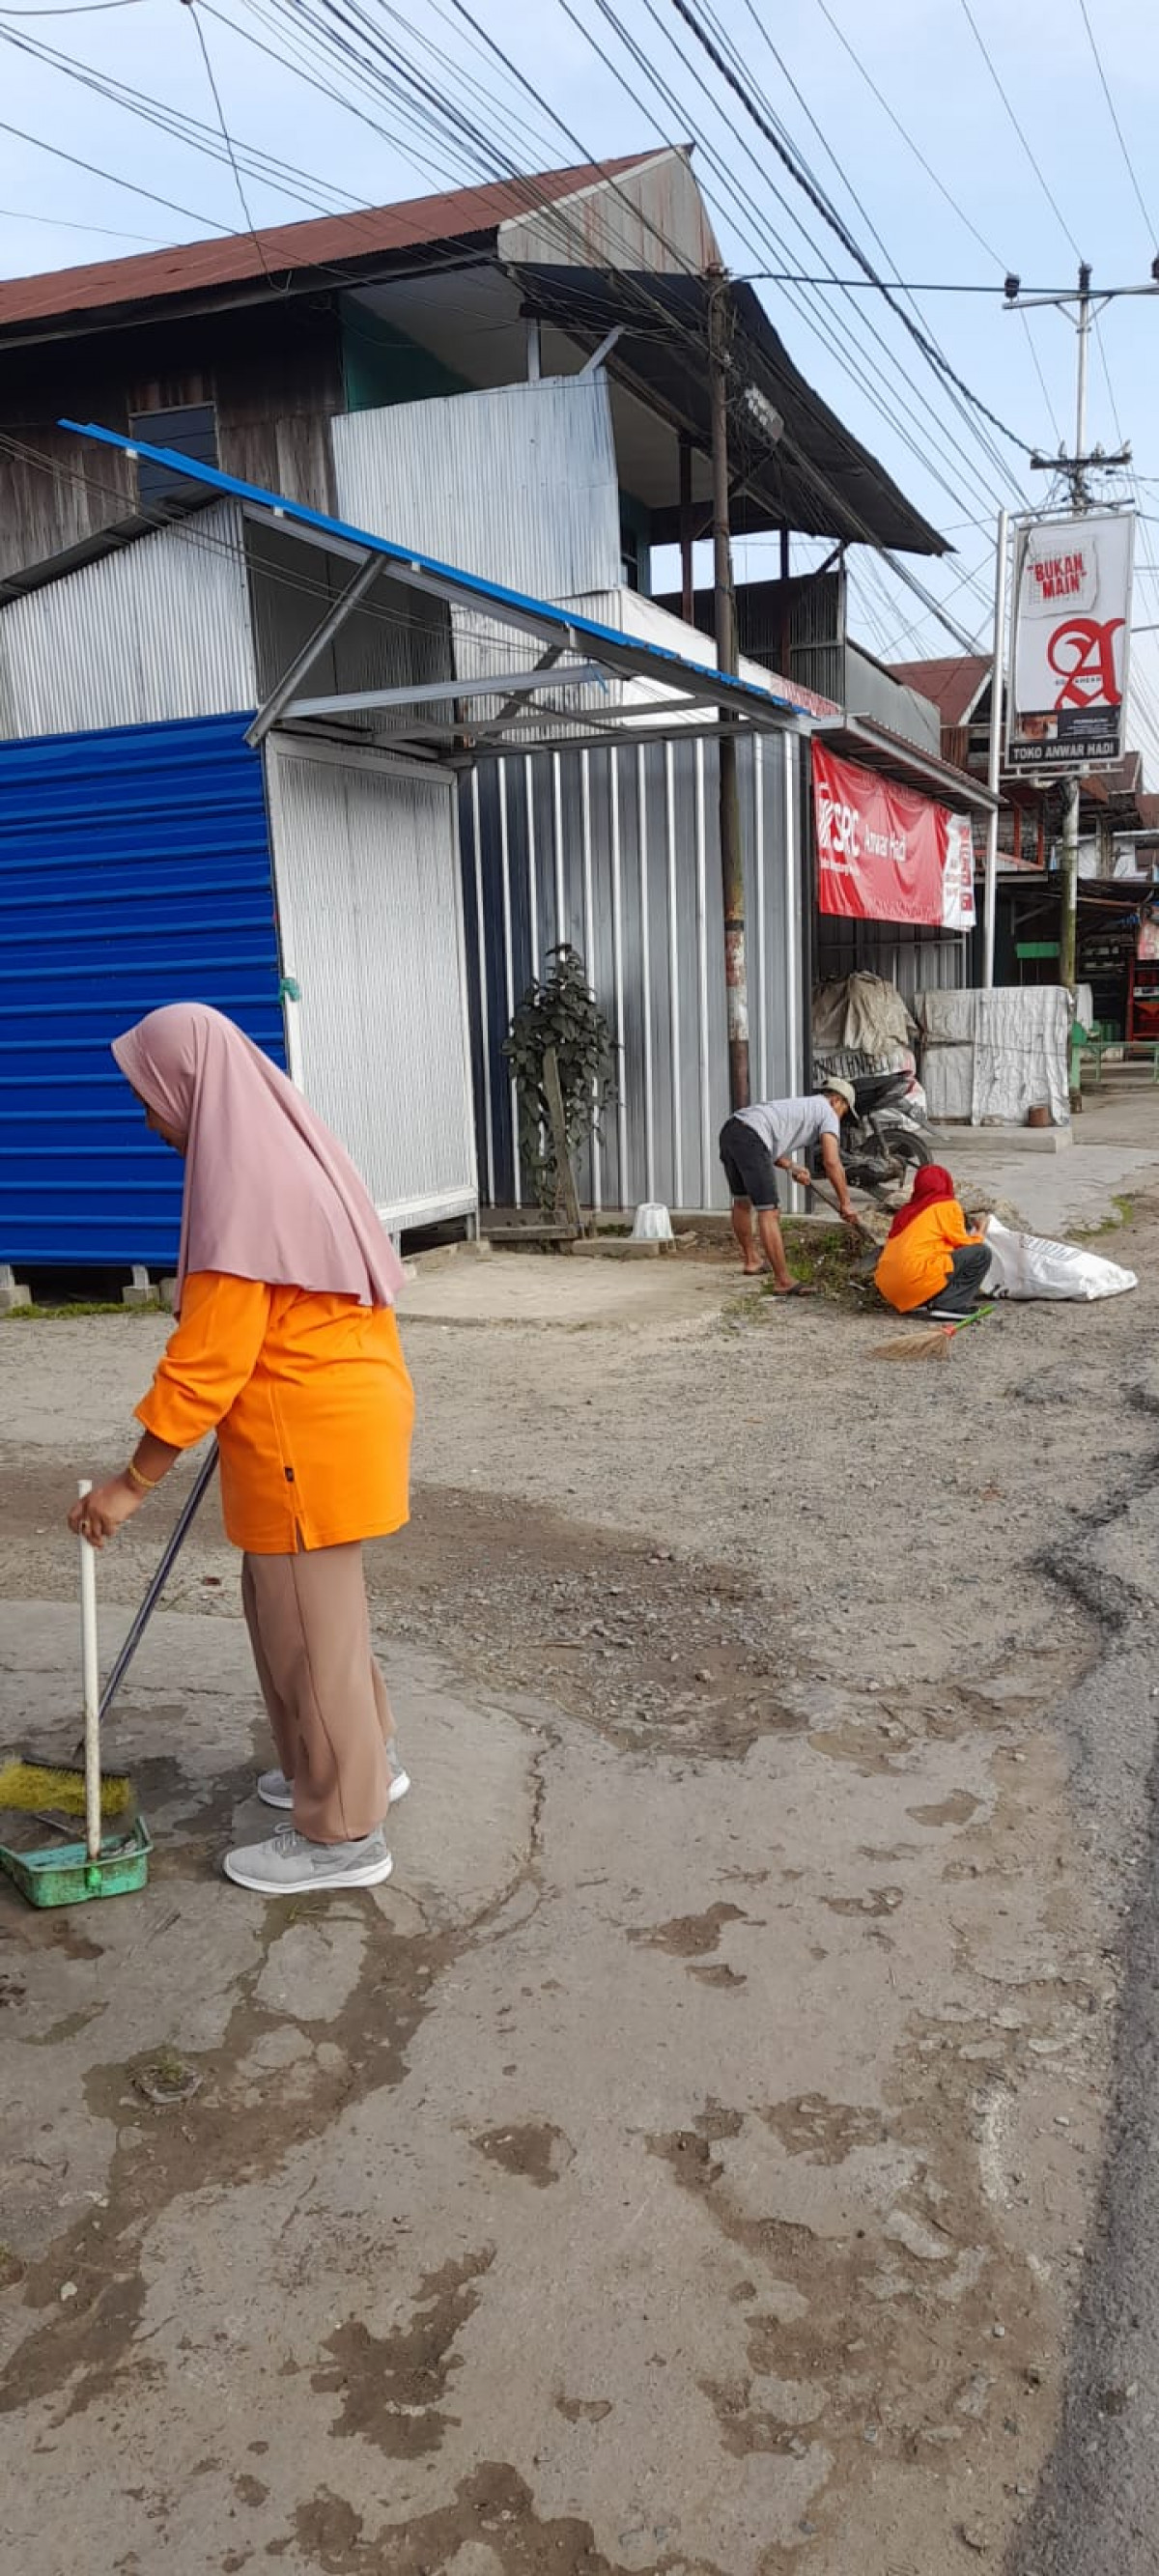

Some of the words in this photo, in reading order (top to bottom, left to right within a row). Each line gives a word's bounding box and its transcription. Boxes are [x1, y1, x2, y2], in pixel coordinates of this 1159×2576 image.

[1013, 747, 1042, 760] TOKO
[1045, 744, 1084, 758] ANWAR
[1088, 741, 1115, 755] HADI
[831, 802, 860, 858] SRC
